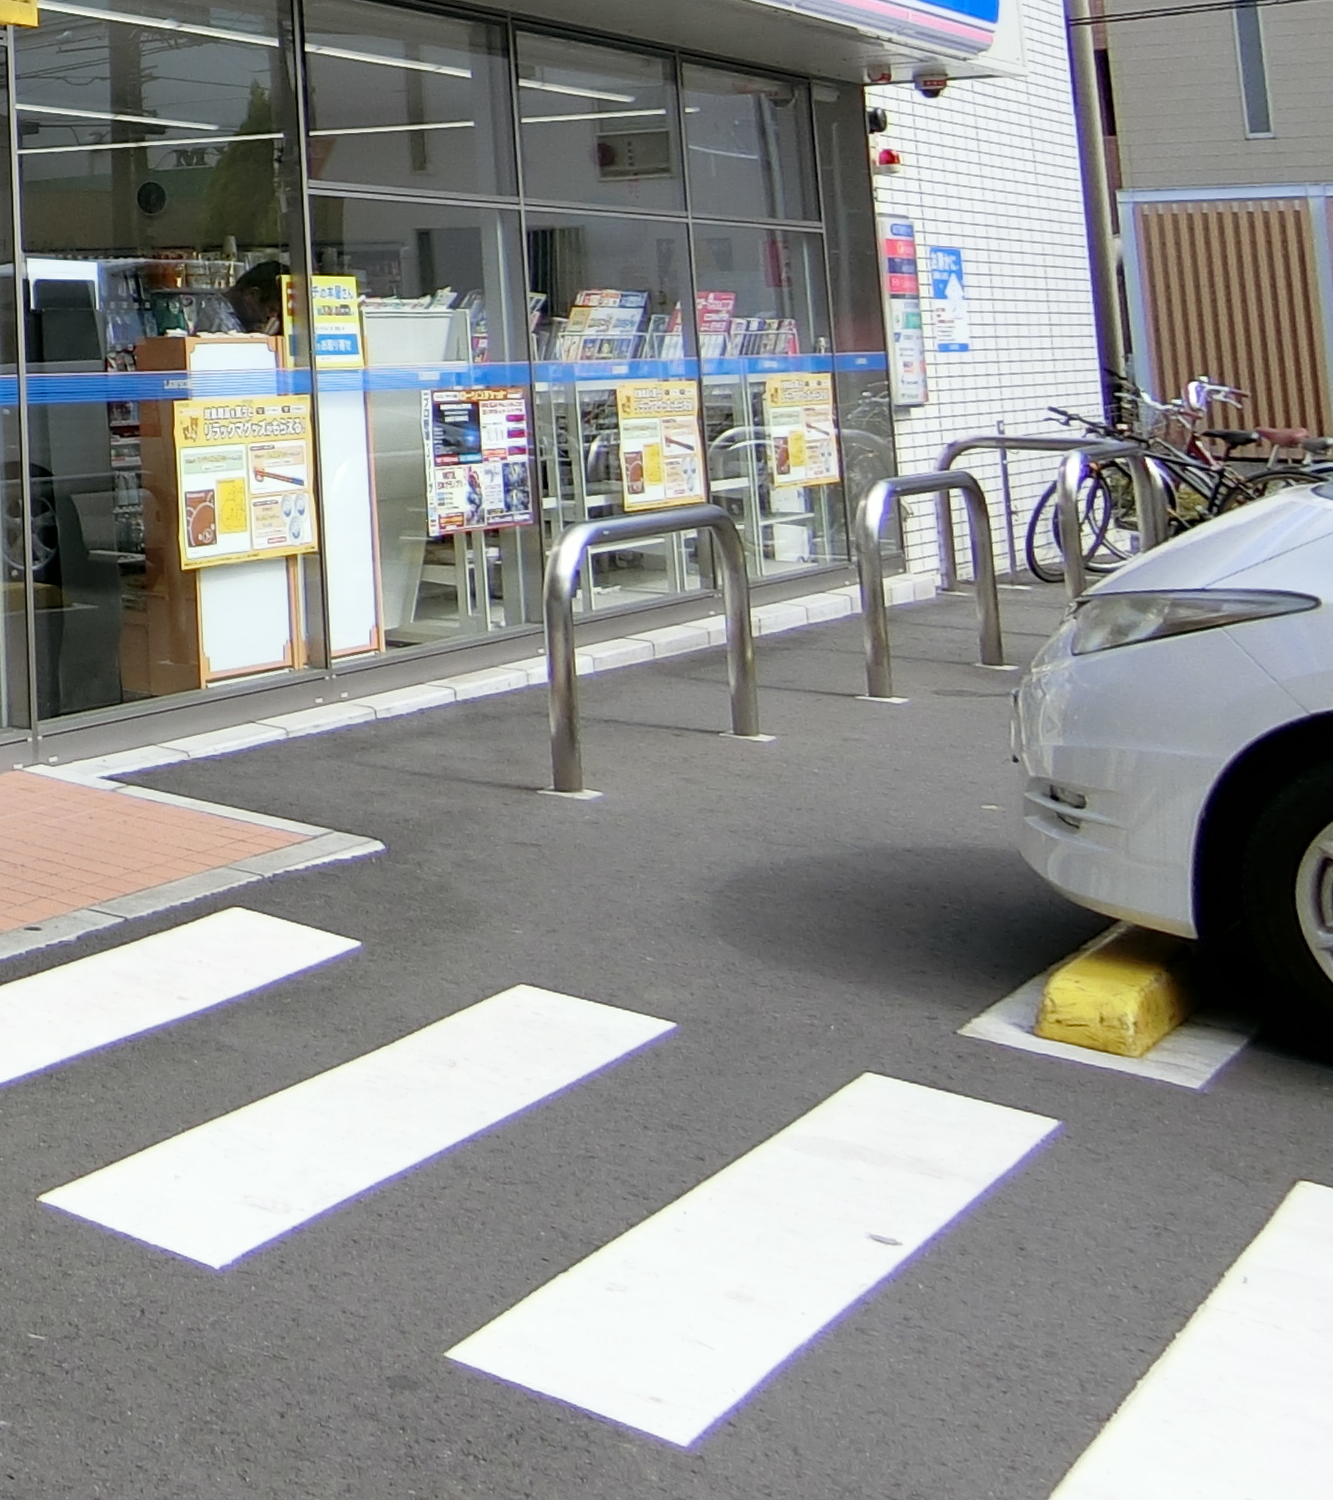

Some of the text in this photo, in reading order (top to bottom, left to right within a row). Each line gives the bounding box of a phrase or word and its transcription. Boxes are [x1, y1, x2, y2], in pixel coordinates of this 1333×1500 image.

[312, 285, 353, 300] チの本屋さん
